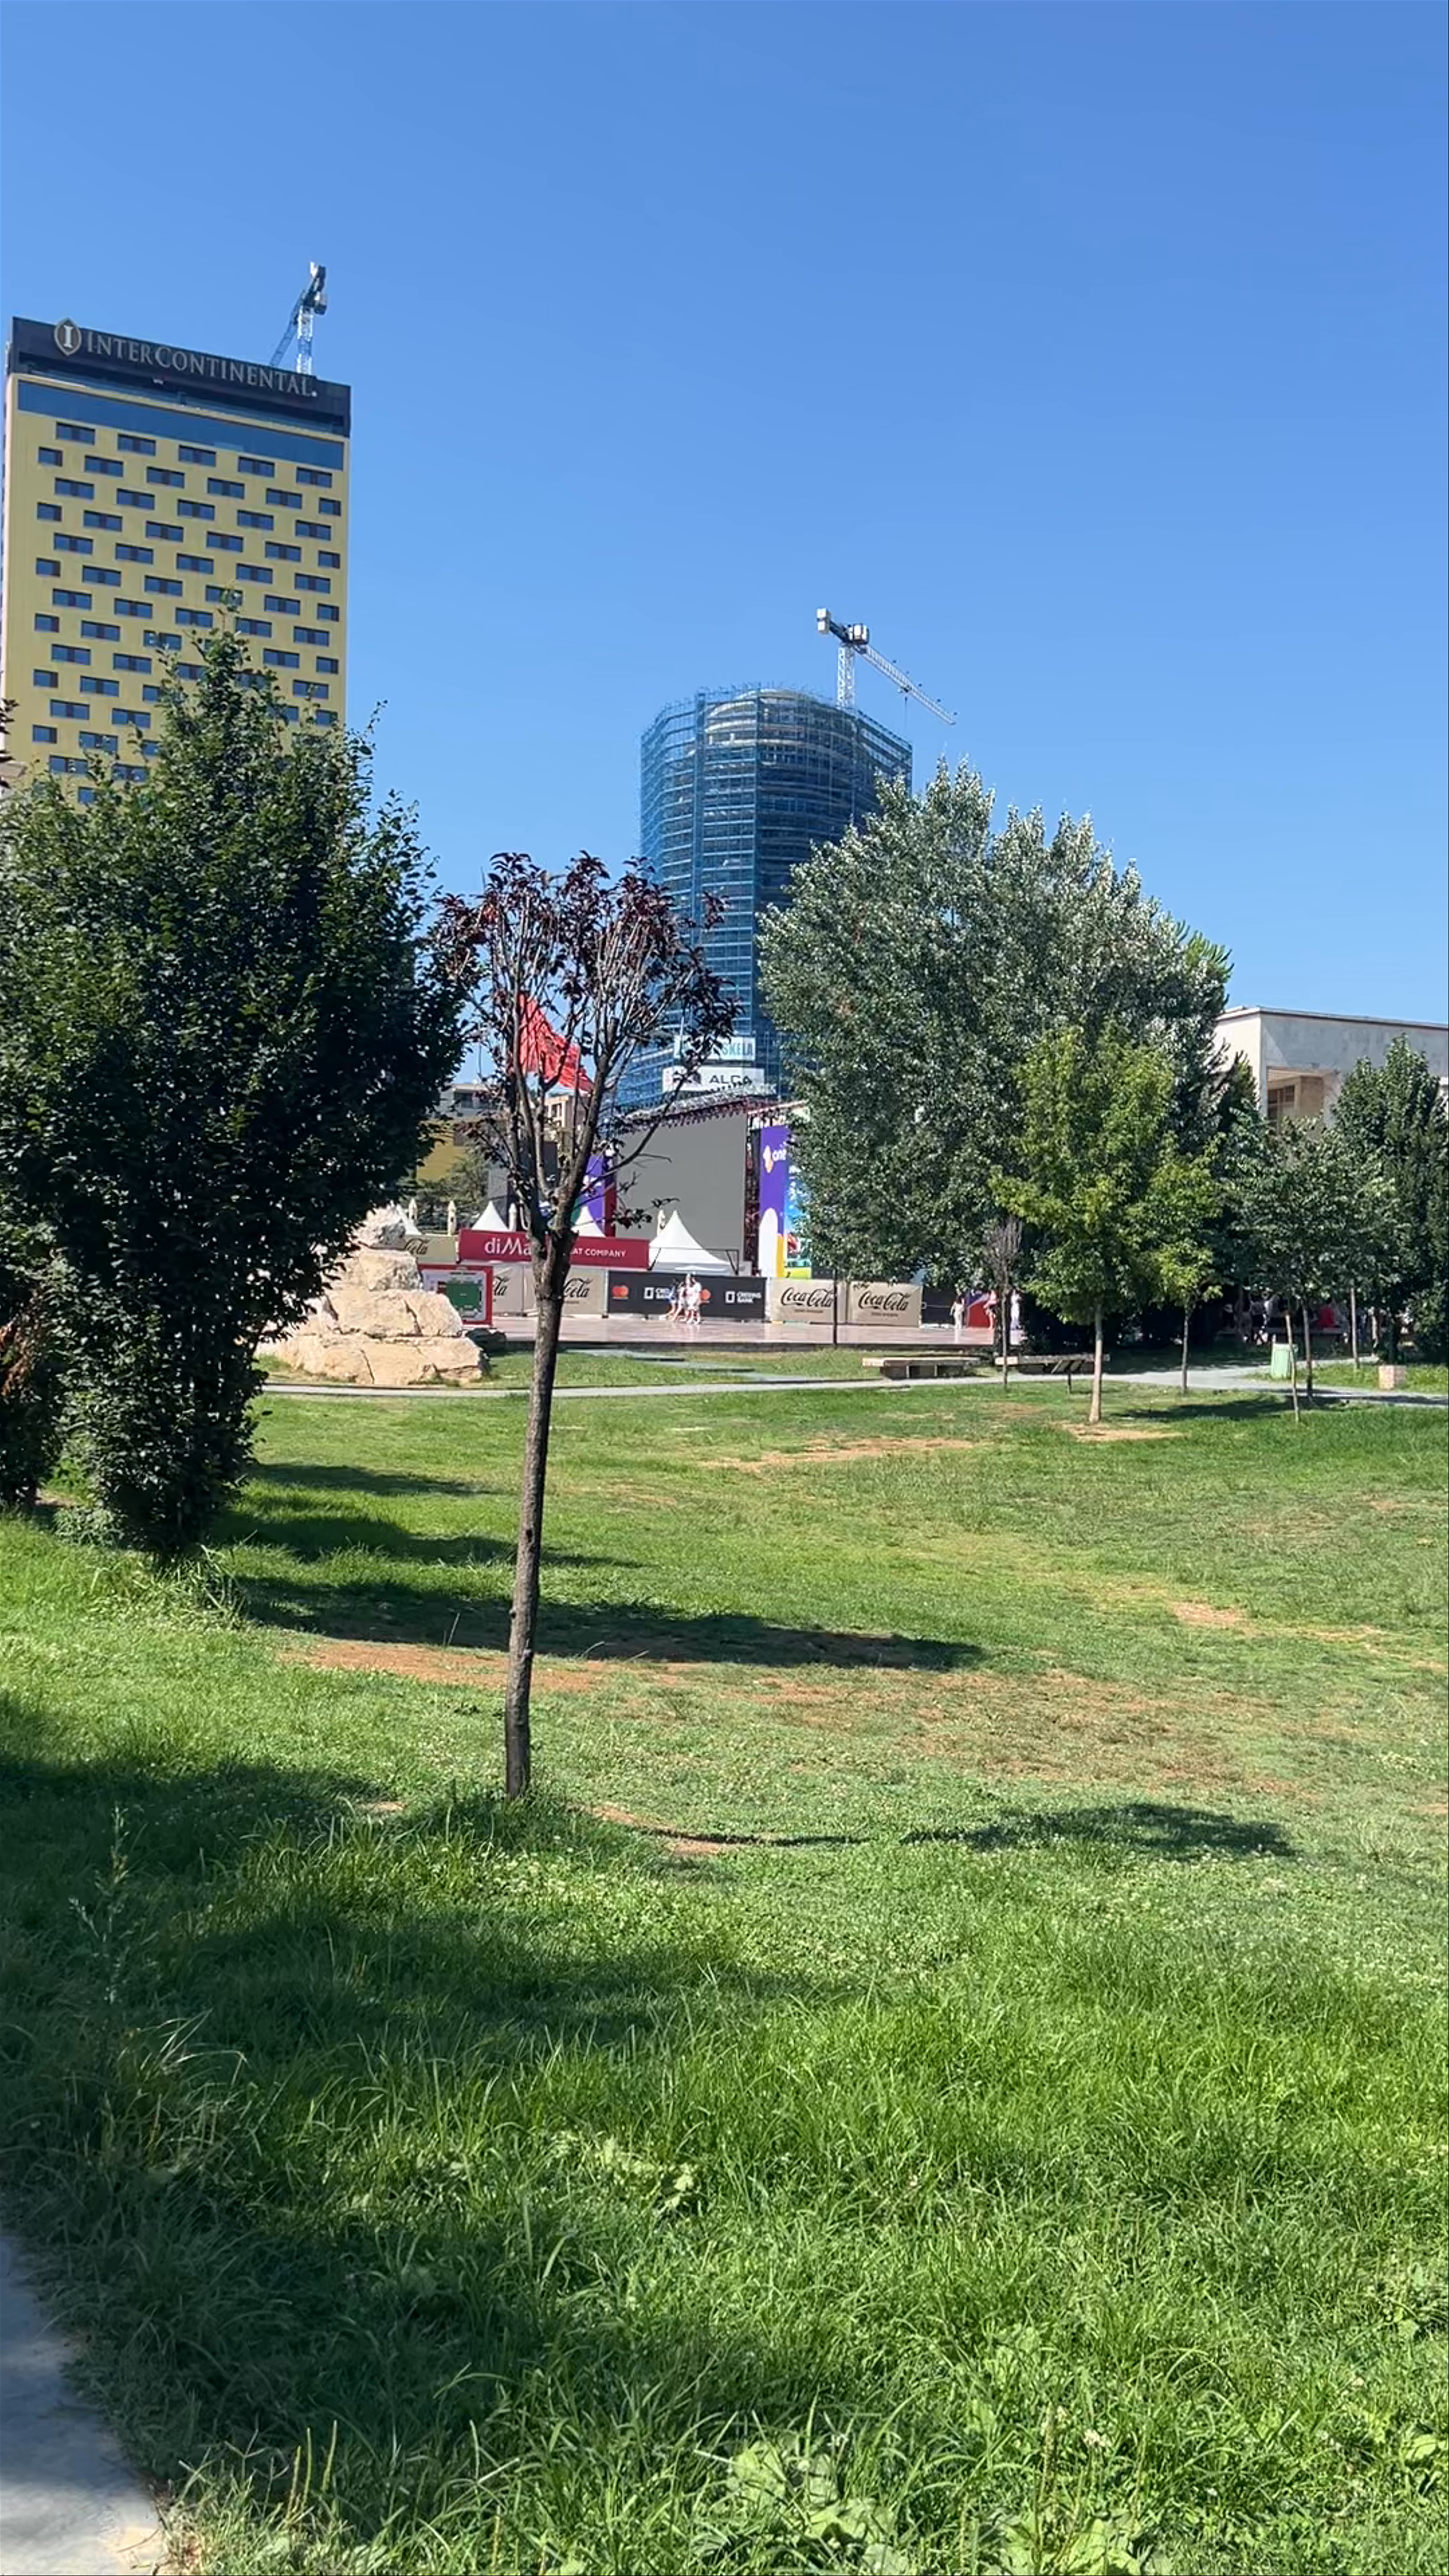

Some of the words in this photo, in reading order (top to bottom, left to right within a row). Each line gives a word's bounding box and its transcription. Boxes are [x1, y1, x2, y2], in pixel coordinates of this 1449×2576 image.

[86, 332, 316, 397] INTERCONTINENTAL
[485, 1237, 531, 1255] diMa
[585, 1248, 626, 1257] COMPANY
